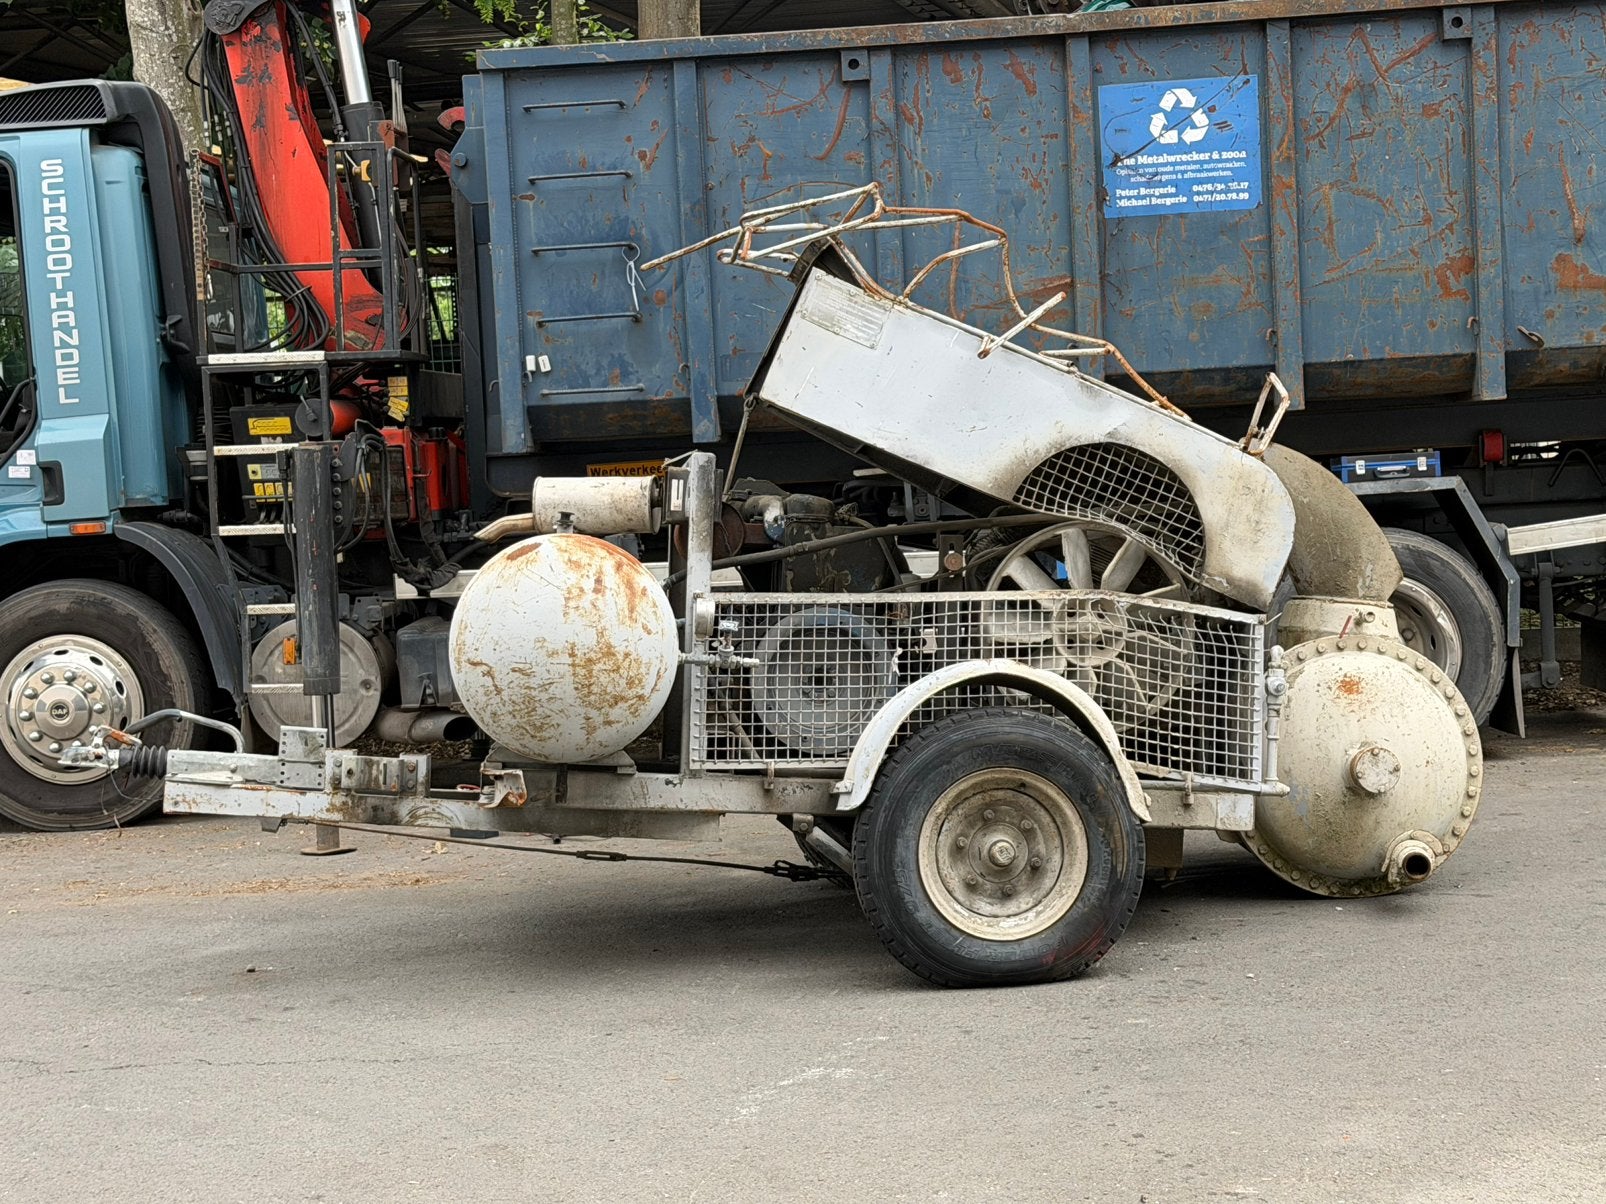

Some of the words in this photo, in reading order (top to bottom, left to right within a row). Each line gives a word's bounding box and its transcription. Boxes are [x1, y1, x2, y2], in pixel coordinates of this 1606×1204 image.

[1137, 152, 1211, 165] Metalwrecker
[1212, 150, 1220, 160] &
[1115, 188, 1139, 197] Peter
[1139, 185, 1177, 196] Bergerie
[1115, 197, 1150, 208] Michael
[1151, 194, 1188, 206] Bergerie
[40, 158, 80, 404] SCHROOTHANDEL
[590, 463, 666, 477] Werkverkee
